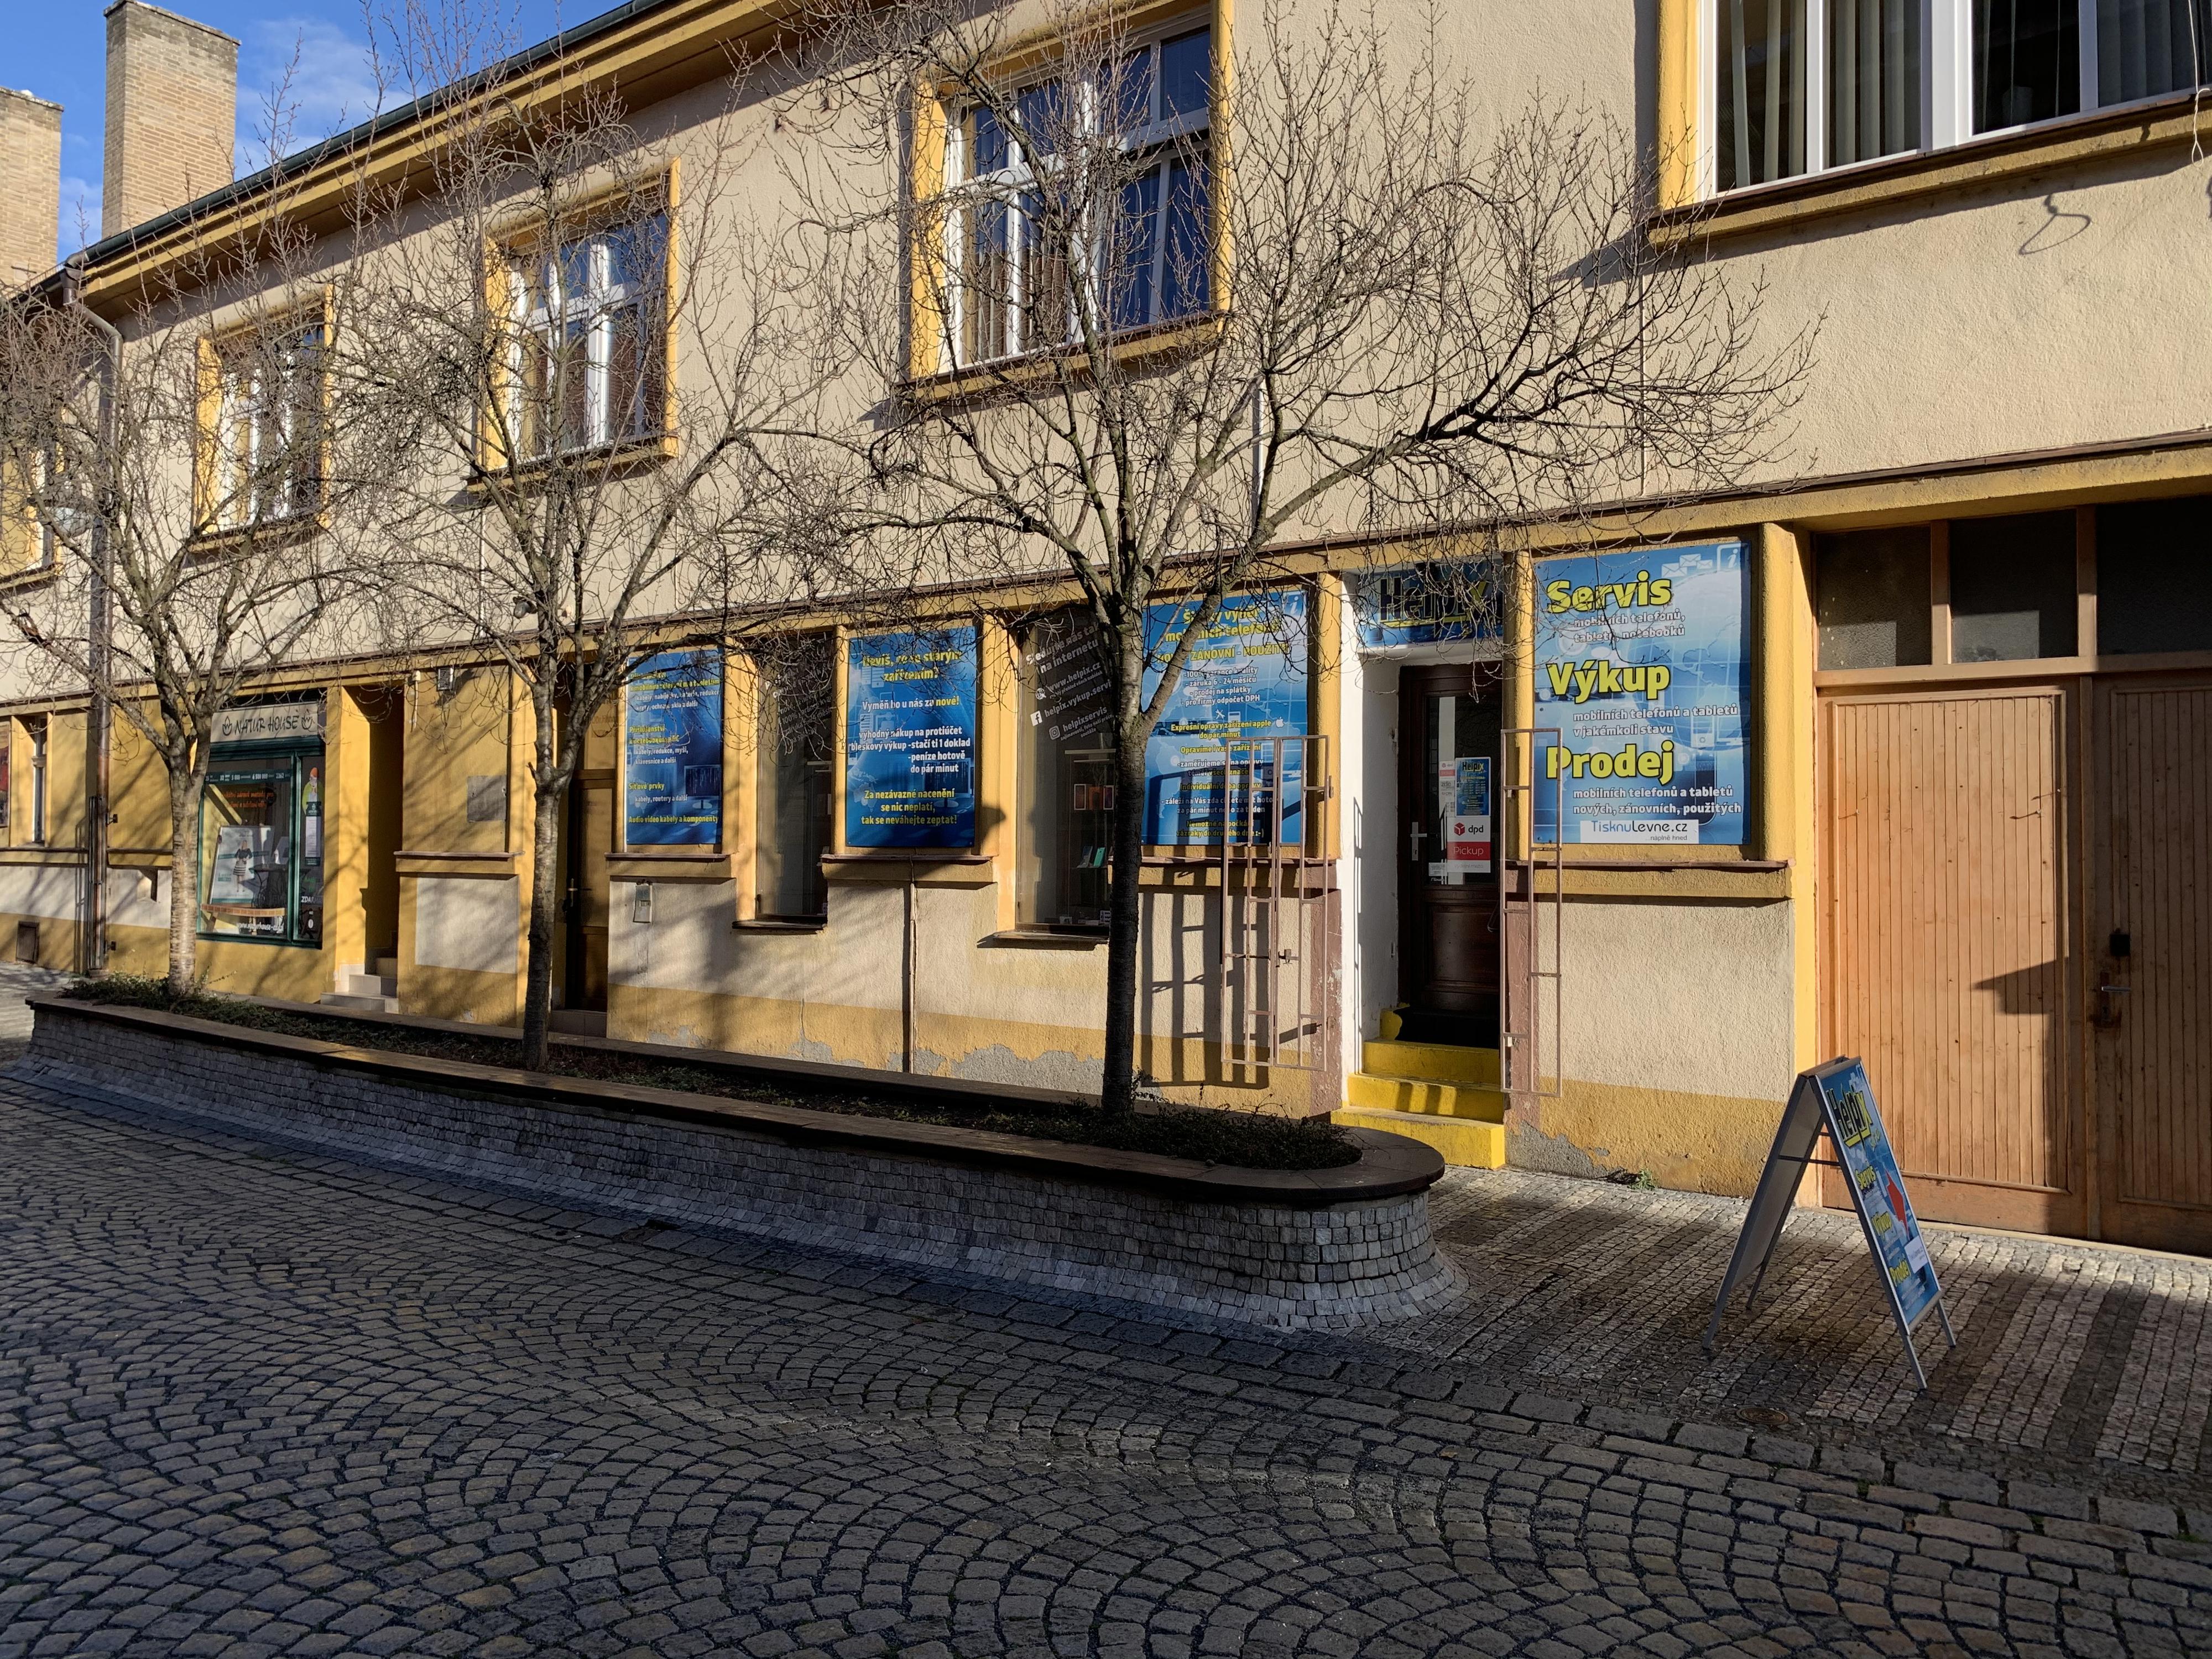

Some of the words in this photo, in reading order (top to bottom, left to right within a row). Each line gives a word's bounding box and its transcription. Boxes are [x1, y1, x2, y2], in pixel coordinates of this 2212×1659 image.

[1547, 570, 1672, 613] Servis
[1631, 608, 1686, 624] telefonů,
[1623, 623, 1686, 639] notebooků
[1040, 662, 1052, 674] na
[1052, 638, 1099, 667] internetu
[1190, 645, 1235, 661] ZÁNOVNÍ
[1190, 679, 1212, 687] záruka
[1233, 676, 1257, 684] měsíců
[1546, 659, 1671, 705] Výkup
[1045, 679, 1112, 717] helpix.vykup.servi
[1193, 687, 1215, 697] prodej
[1225, 686, 1251, 697] splátky
[862, 699, 889, 712] Vyměň
[909, 698, 923, 708] nás
[925, 699, 935, 707] za
[936, 695, 959, 706] nové!
[1185, 700, 1197, 708] pro
[1198, 697, 1216, 706] firmy
[1217, 696, 1244, 706] odpočet
[1245, 694, 1260, 702] DPH
[1062, 706, 1108, 732] helpixservis
[1573, 708, 1628, 722] mobilních
[1630, 706, 1681, 719] telefonů
[1683, 708, 1691, 717] a
[1692, 702, 1739, 717] tabletů
[234, 718, 265, 735] NATUR
[268, 715, 299, 732] HOUSE
[1171, 723, 1199, 732] Expresní
[1200, 723, 1223, 731] opravy
[1224, 720, 1252, 729] zařízení
[1253, 719, 1272, 729] apple
[1573, 728, 1581, 737] v
[1582, 723, 1638, 739] jakémkoli
[1640, 724, 1674, 735] stavu
[859, 729, 890, 741] výhodný
[891, 727, 913, 739] nákup
[915, 728, 924, 736] na
[925, 726, 962, 738] protiúčet
[1209, 731, 1219, 740] pár
[851, 741, 883, 752] bleskový
[884, 740, 907, 753] výkup
[931, 738, 938, 748] ti
[944, 738, 971, 747] doklad
[1180, 745, 1212, 754] Opravíme
[1233, 743, 1262, 752] zařízní
[937, 750, 966, 761] hotově
[1546, 739, 1675, 786] Prodej
[910, 764, 920, 774] do
[921, 764, 934, 775] pár
[935, 763, 959, 773] minut
[1462, 761, 1484, 772] Helpix
[649, 782, 665, 791] prvky
[864, 790, 874, 799] Za
[875, 789, 916, 799] nezávazné
[918, 788, 955, 798] nacenění
[1237, 782, 1261, 791] oprvy
[1573, 787, 1627, 799] mobilních
[1628, 785, 1678, 798] telefonů
[1680, 788, 1687, 797] a
[1688, 784, 1734, 798] tabletů
[880, 804, 891, 812] se
[891, 802, 902, 812] nic
[904, 802, 936, 814] neplatí,
[1186, 806, 1197, 816] pár
[1573, 803, 1617, 817] nových,
[1618, 802, 1681, 816] zánovních,
[1683, 801, 1743, 817] použitých
[684, 815, 718, 824] komponenty
[861, 816, 874, 825] tak
[885, 815, 925, 826] neváhejte
[926, 815, 957, 826] zeptat!
[1176, 830, 1204, 839] zázraky
[1468, 825, 1484, 834] dpd
[1453, 846, 1484, 856] Pickup
[1826, 1083, 1874, 1149] Helpix
[1855, 1164, 1876, 1190] Servis
[1871, 1211, 1891, 1241] Výkup
[1889, 1255, 1911, 1287] Prodej
